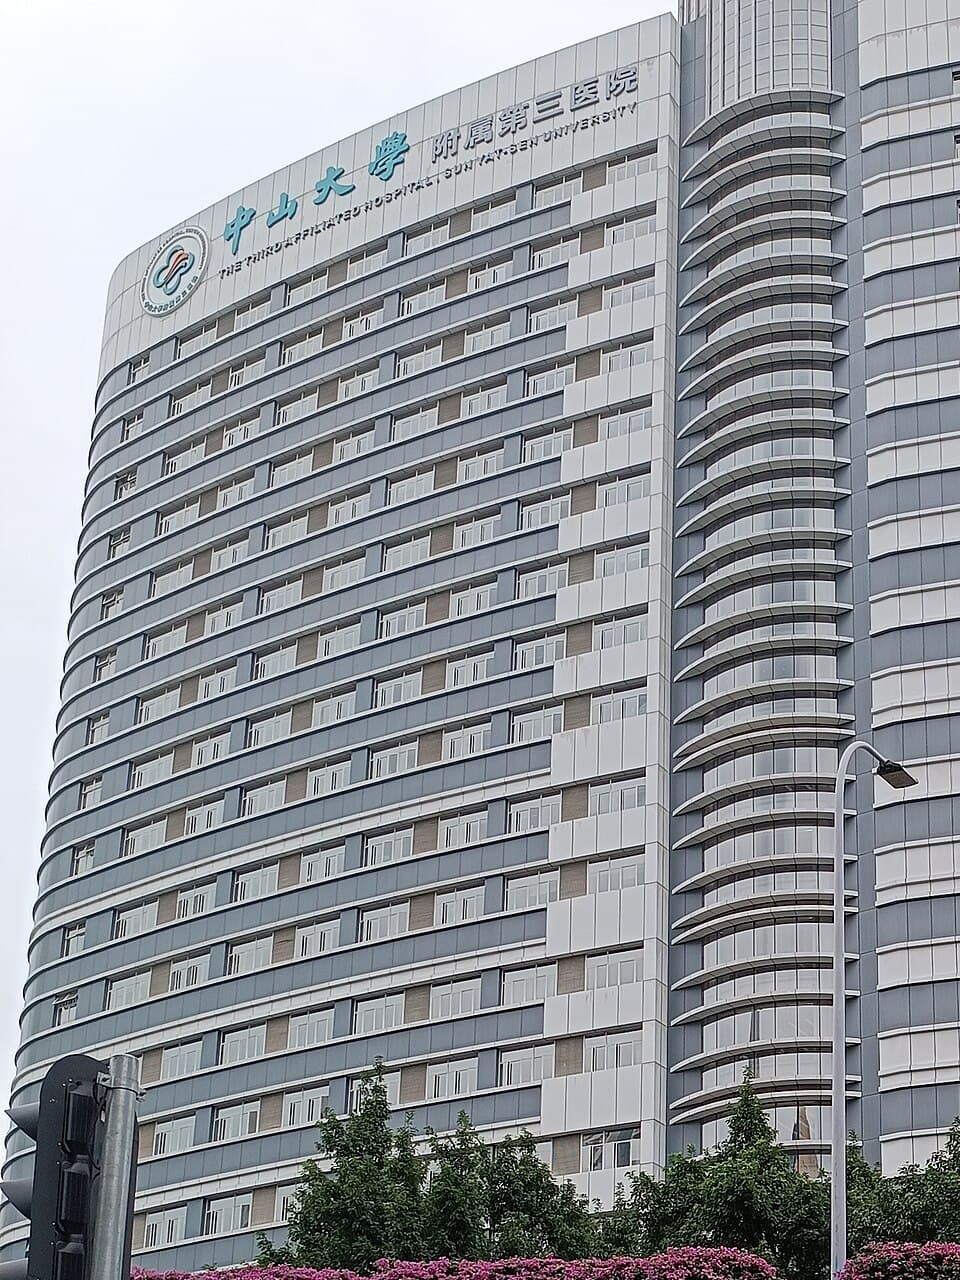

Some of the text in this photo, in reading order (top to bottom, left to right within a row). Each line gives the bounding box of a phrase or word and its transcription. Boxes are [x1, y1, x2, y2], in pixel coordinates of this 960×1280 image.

[431, 65, 639, 164] 附属第三医院
[218, 258, 243, 280] THE
[243, 239, 282, 265] THIRD
[281, 206, 362, 252] AFFILIATED
[444, 155, 474, 180] SUN
[542, 100, 637, 143] UNIVERSITY
